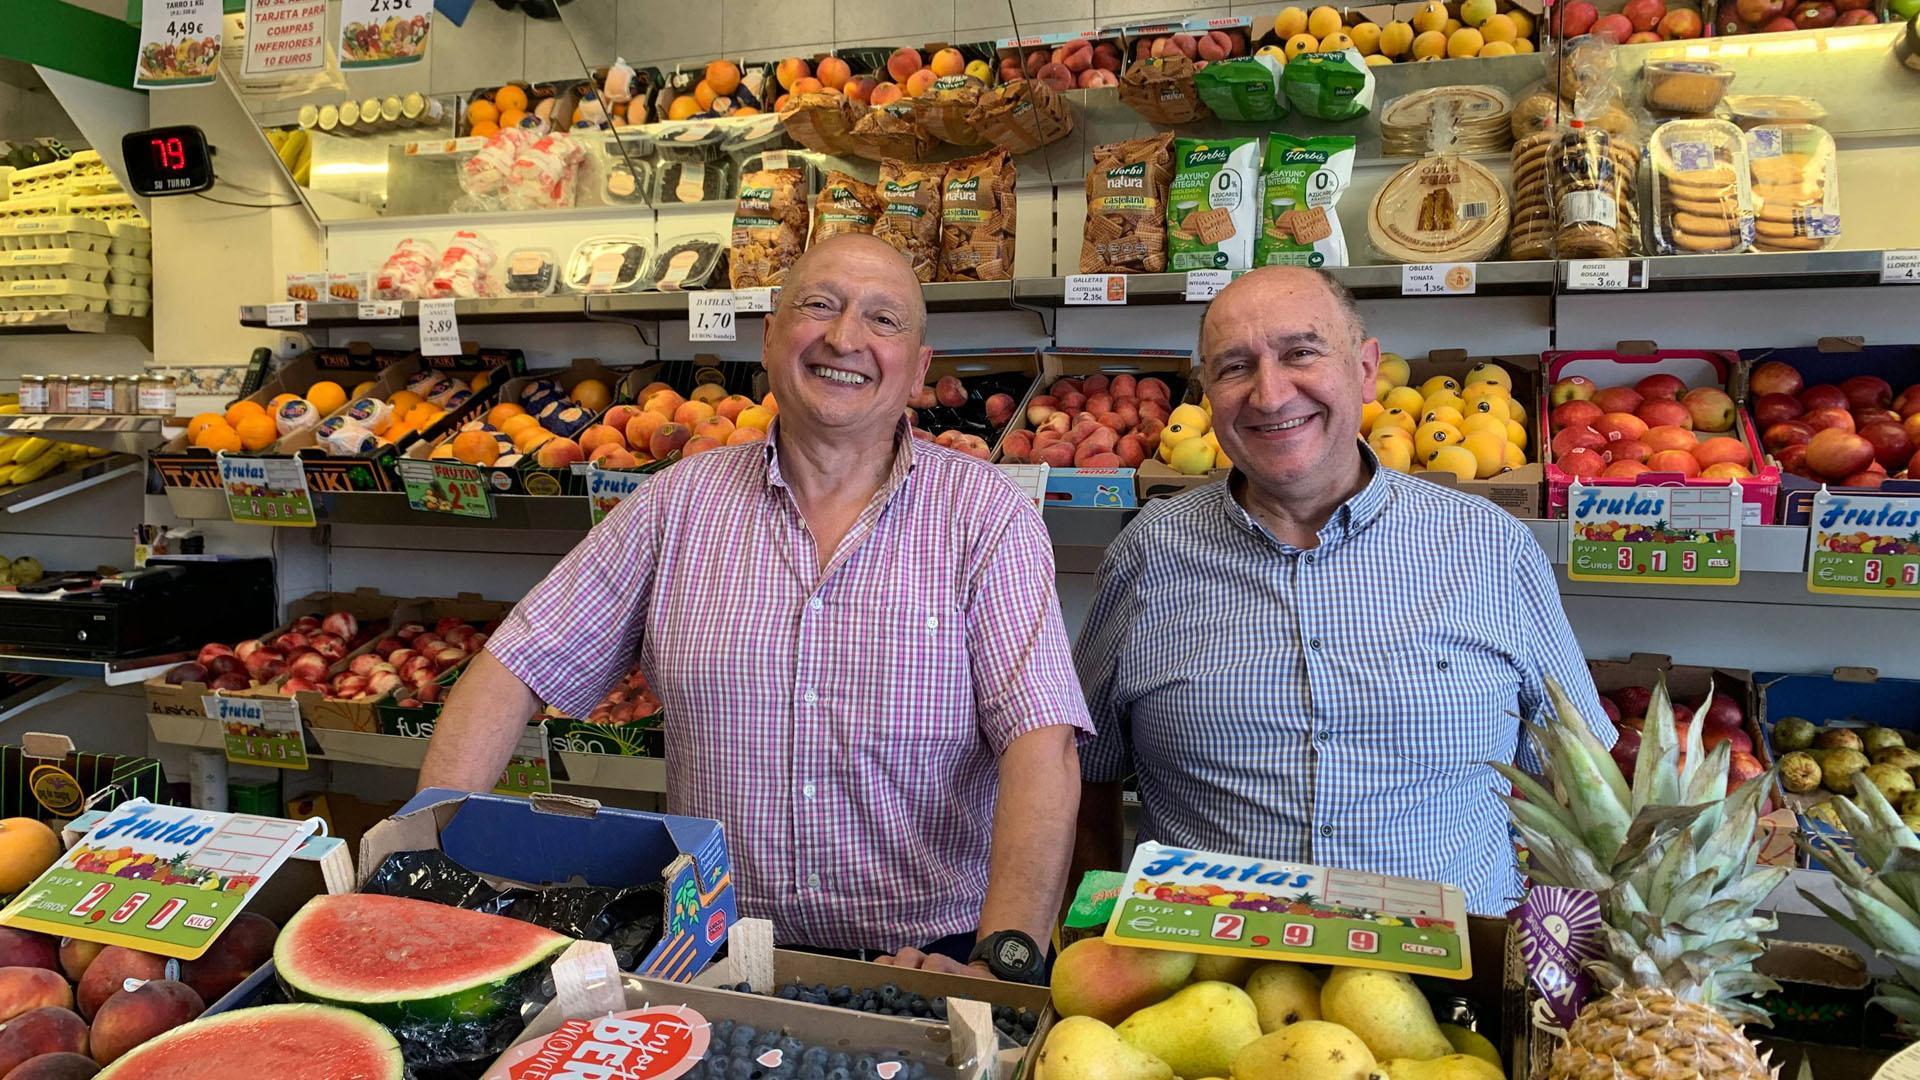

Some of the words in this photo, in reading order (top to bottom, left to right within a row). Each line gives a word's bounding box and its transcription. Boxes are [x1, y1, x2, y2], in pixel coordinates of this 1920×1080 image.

[255, 11, 298, 23] TARJETA
[302, 5, 326, 16] PARA
[267, 22, 314, 36] COMPRAS
[255, 38, 313, 53] INFERIORES
[316, 37, 322, 46] A
[264, 56, 275, 66] 10
[278, 53, 312, 65] EUROS
[151, 137, 185, 170] 79
[1190, 149, 1227, 165] Florbú
[1285, 151, 1325, 162] Florbú
[154, 180, 163, 190] SU
[167, 177, 191, 189] TURNO
[1107, 175, 1143, 189] natura
[1175, 172, 1210, 181] ESAYUNO
[945, 191, 977, 201] natura
[741, 198, 770, 210] natura
[427, 319, 452, 333] 3,89
[697, 312, 731, 330] 1,70
[222, 459, 264, 480] Frutas
[1575, 489, 1665, 518] Frutas
[1820, 498, 1920, 529] Frutas
[218, 699, 261, 719] Frutas
[95, 804, 214, 846] Frutas
[1142, 849, 1315, 890] Frutas
[187, 915, 215, 929] KILO
[1402, 943, 1443, 956] KILO
